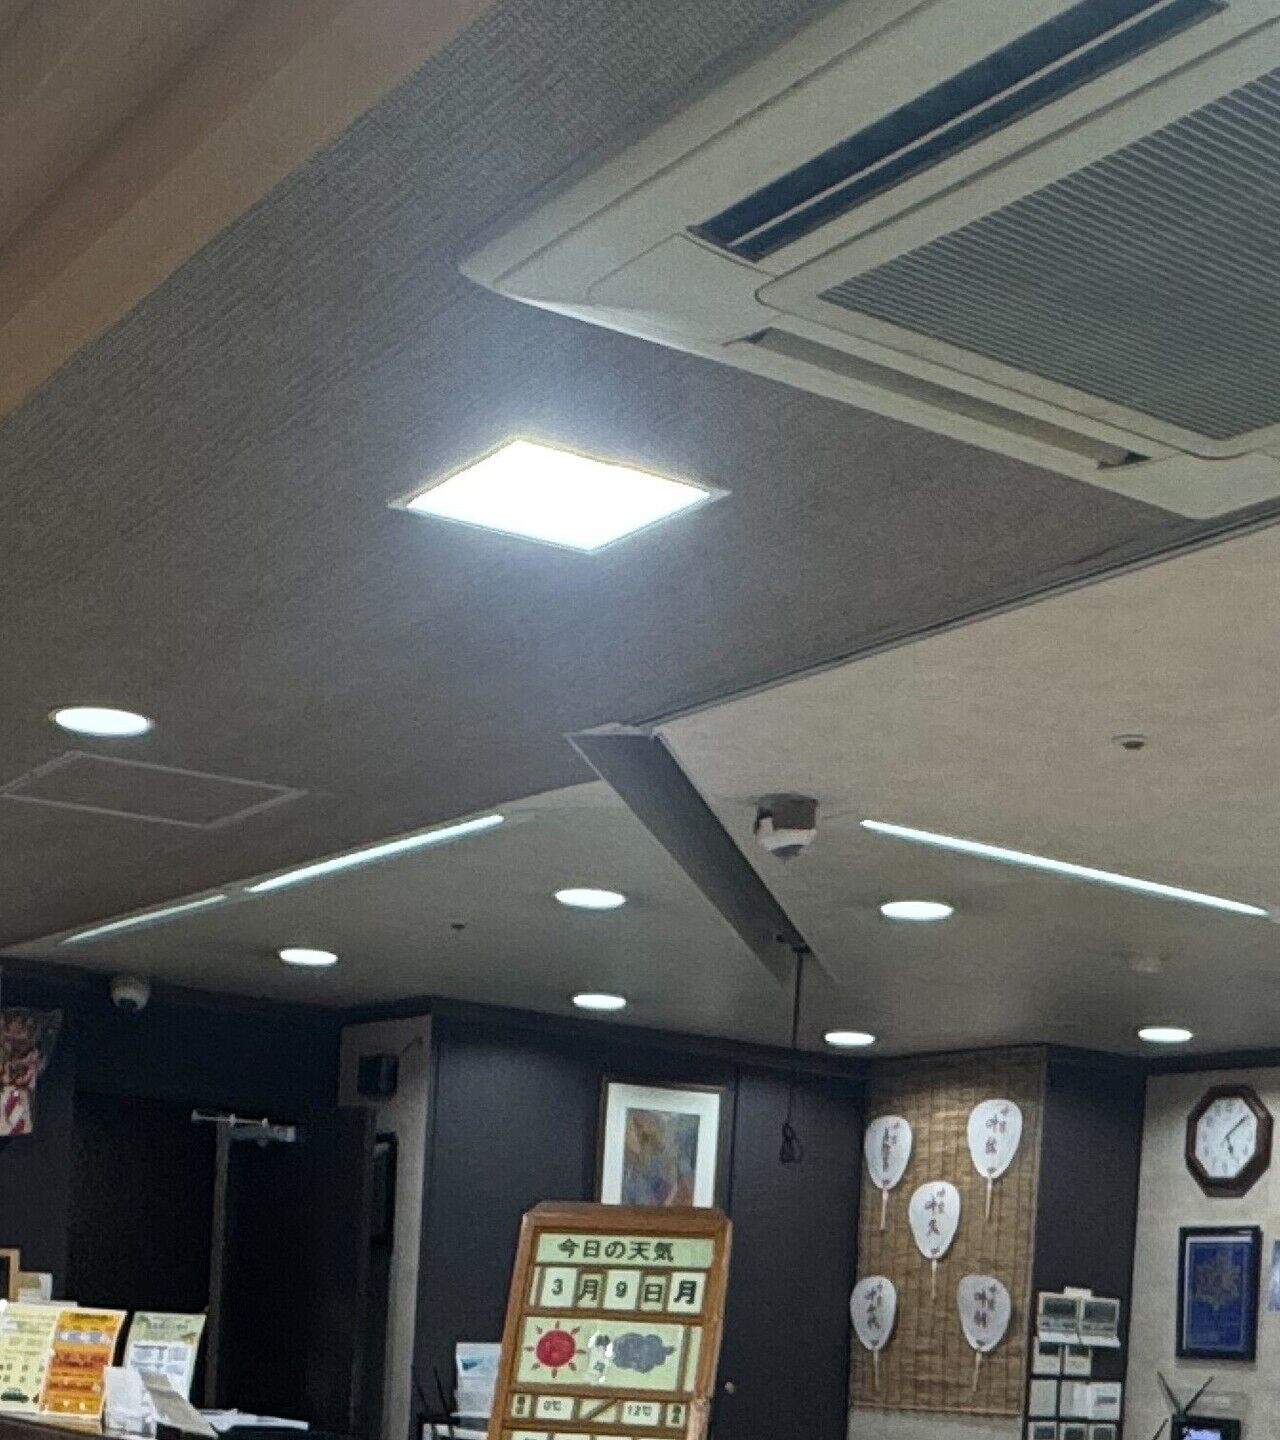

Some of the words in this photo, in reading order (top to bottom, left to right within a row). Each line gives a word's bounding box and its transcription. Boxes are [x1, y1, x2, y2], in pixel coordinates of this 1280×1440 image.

[557, 1238, 675, 1263] 今日の天気
